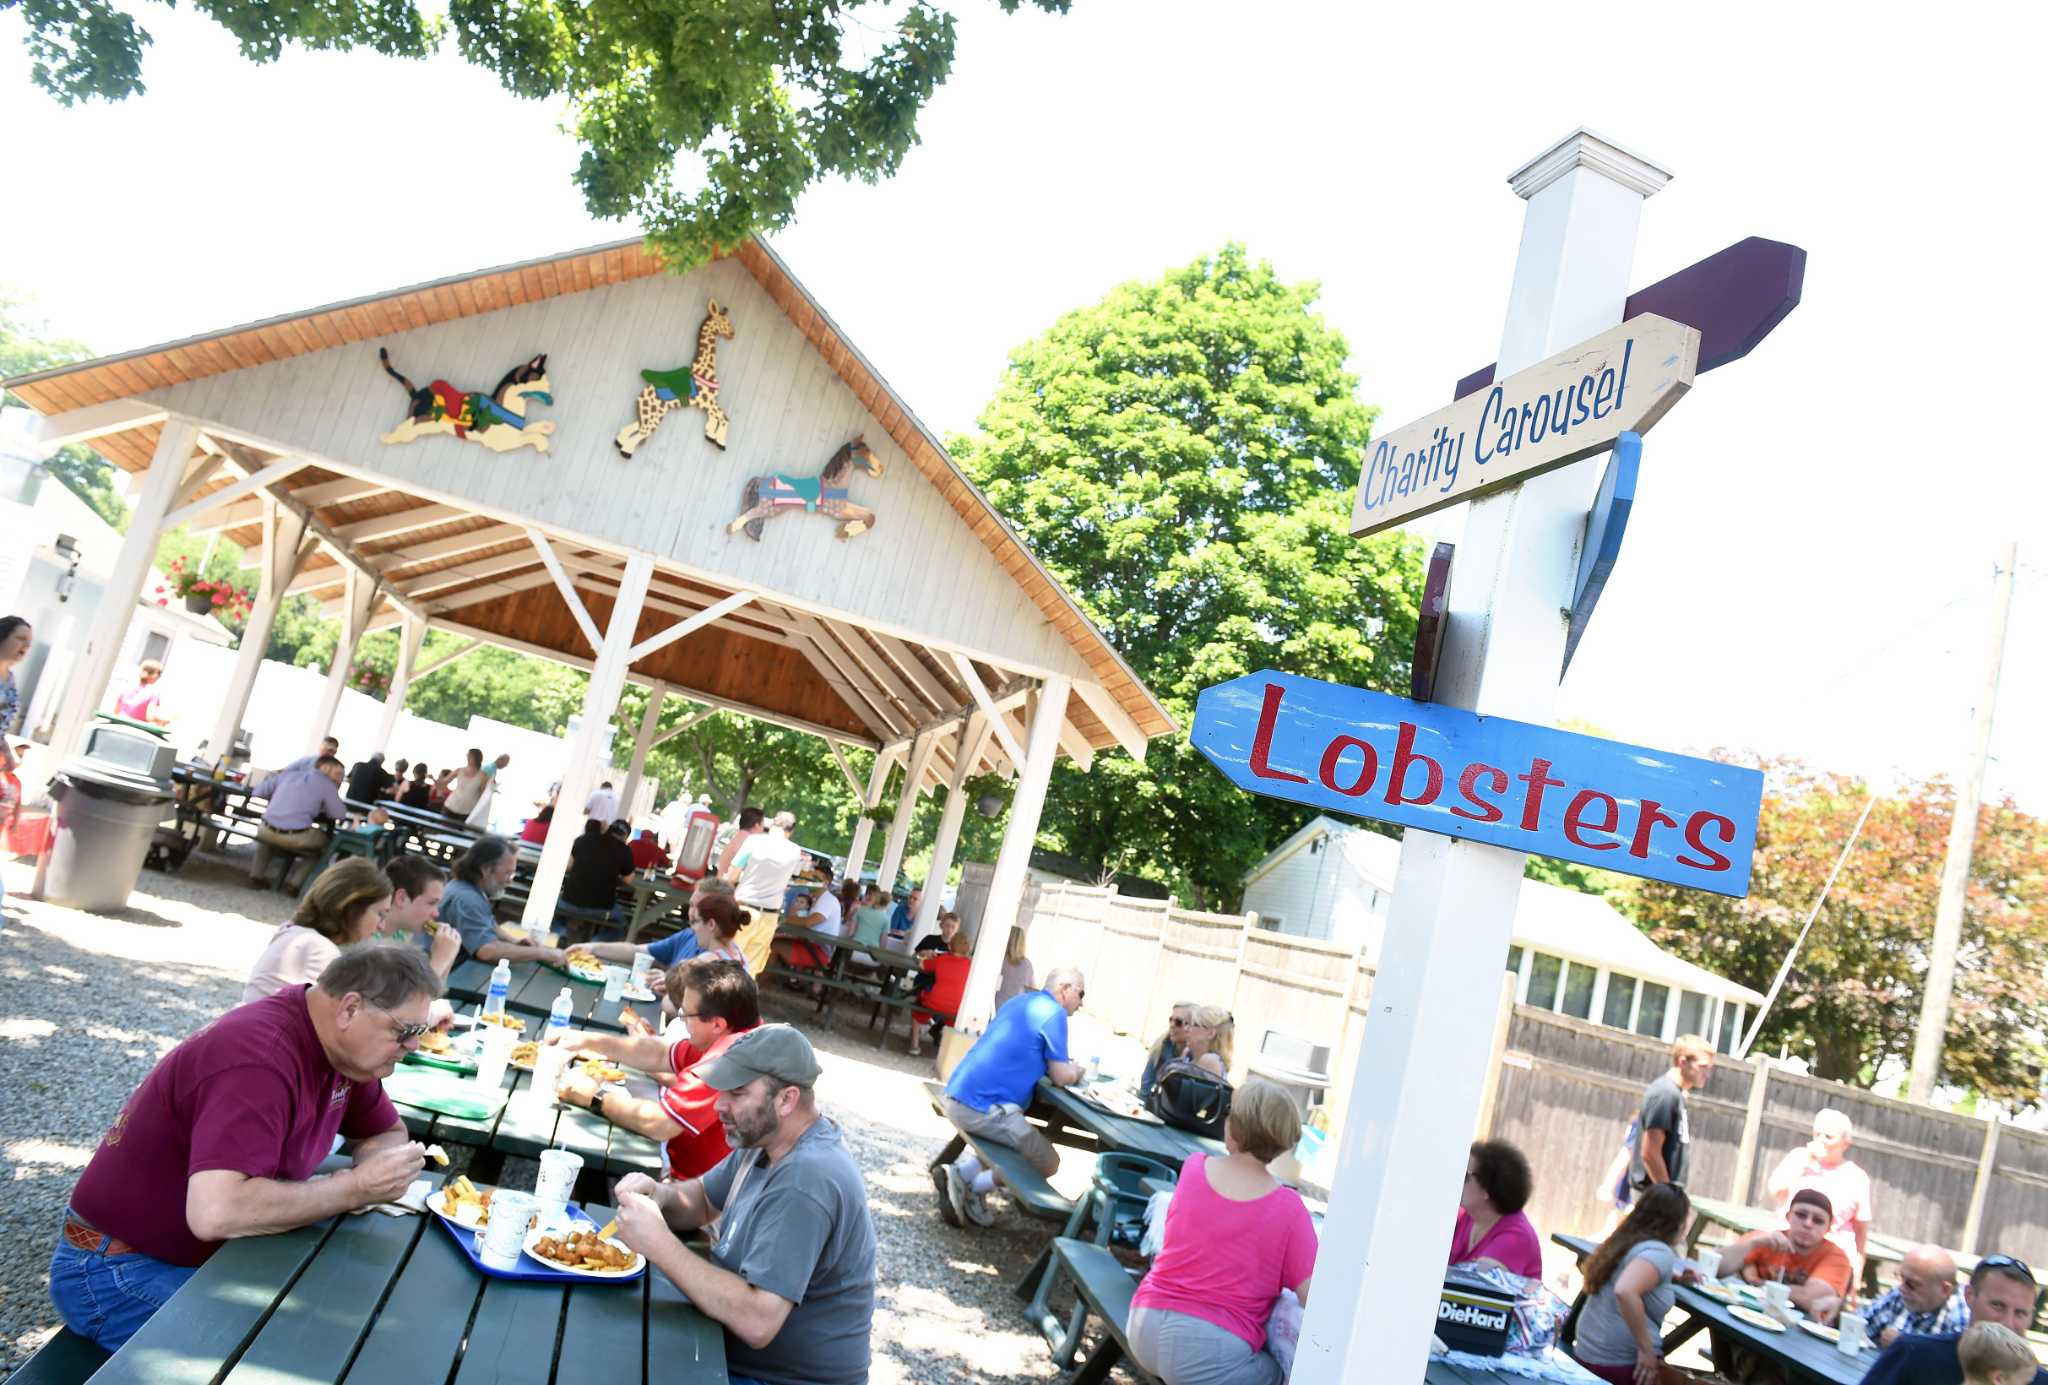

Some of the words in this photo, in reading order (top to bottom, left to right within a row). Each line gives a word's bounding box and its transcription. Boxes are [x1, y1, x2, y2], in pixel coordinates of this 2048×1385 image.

[1364, 426, 1465, 510] Charity
[1474, 338, 1634, 465] Carousel
[1248, 683, 1737, 872] Lobsters
[1438, 1301, 1507, 1330] DieHard
